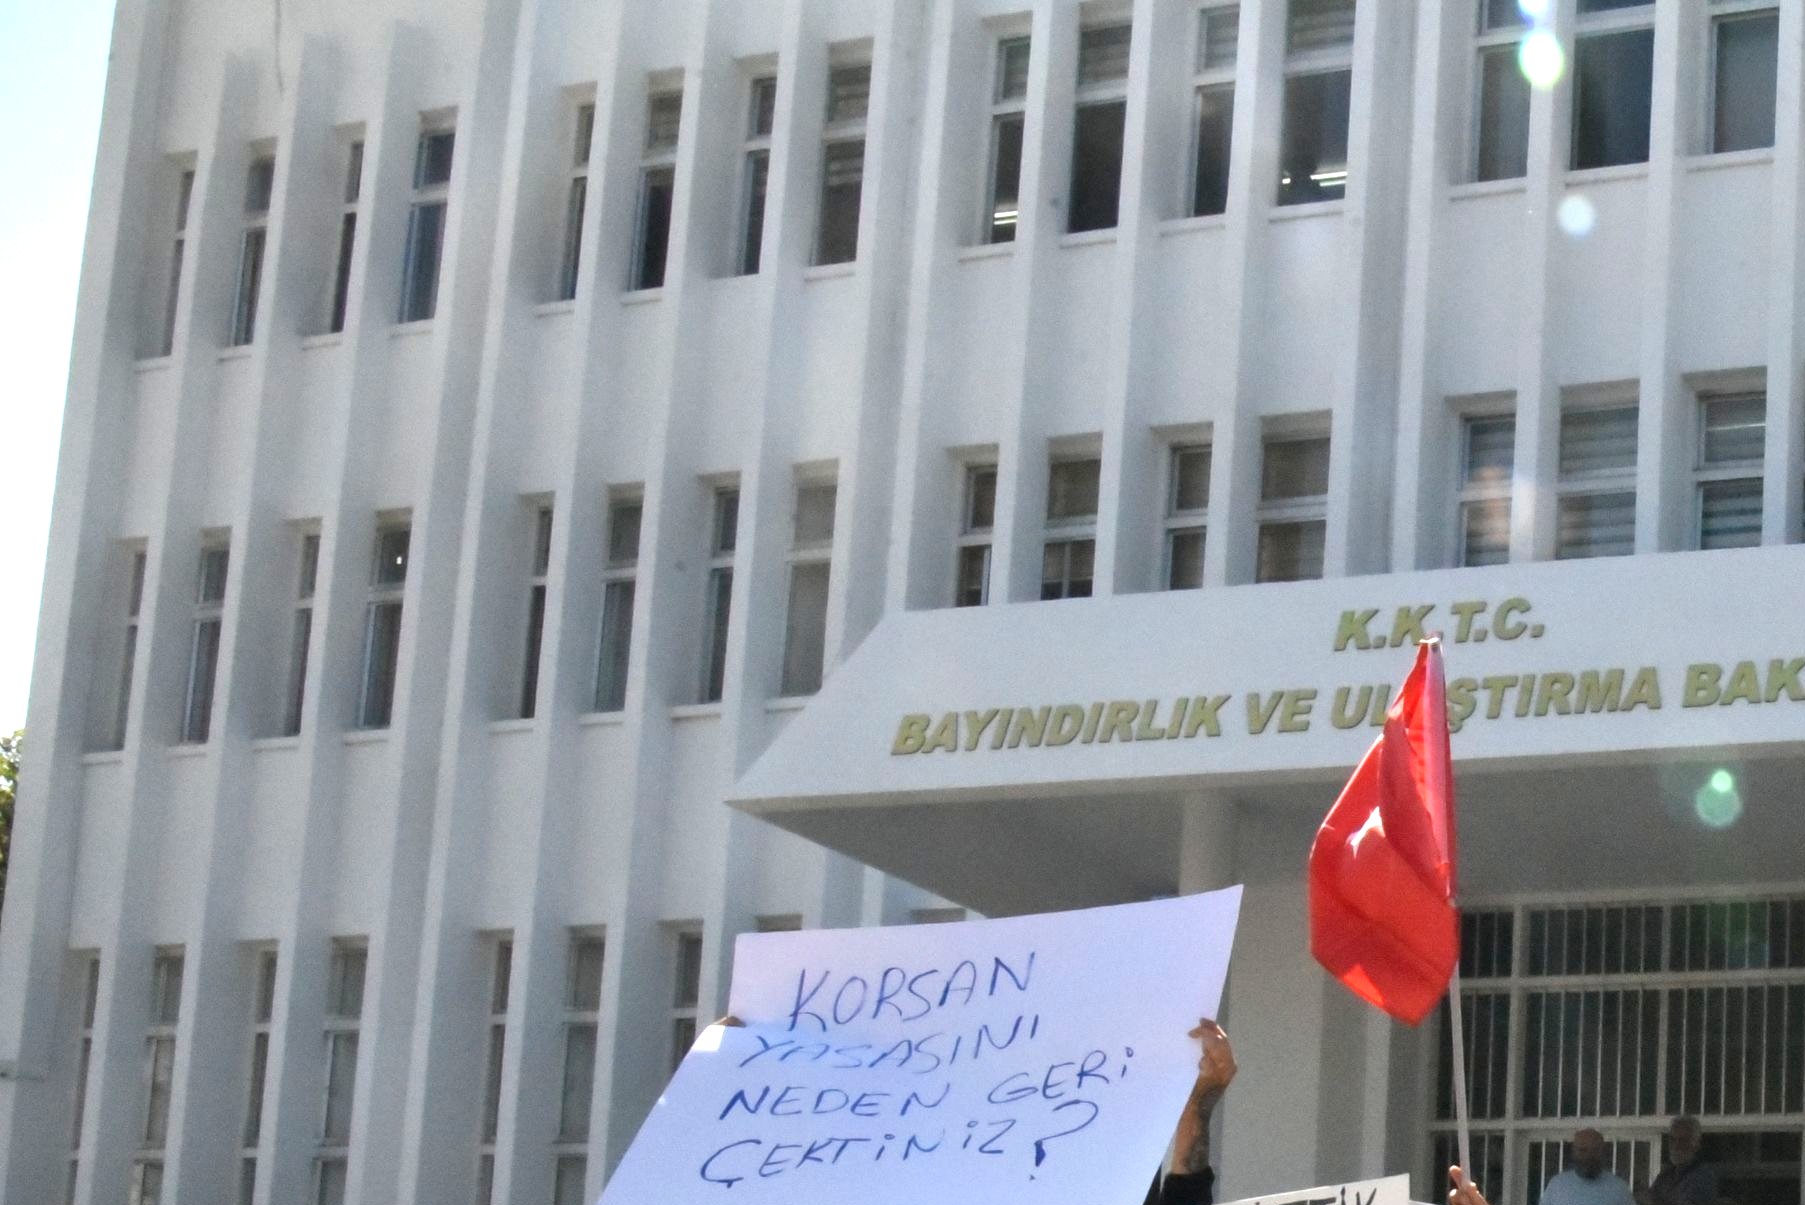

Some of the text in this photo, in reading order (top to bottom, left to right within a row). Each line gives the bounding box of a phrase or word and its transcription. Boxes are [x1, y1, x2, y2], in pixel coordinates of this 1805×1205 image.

[1334, 597, 1545, 652] K.K.T.C.
[890, 692, 1232, 756] BAYINDIRLIK
[1247, 686, 1314, 735] VE
[1331, 664, 1662, 734] ULŞTIRMA
[785, 951, 1037, 1033] KORSAN
[738, 1014, 1039, 1077] YASASINI
[717, 1046, 1136, 1122] NEDEN GERİ
